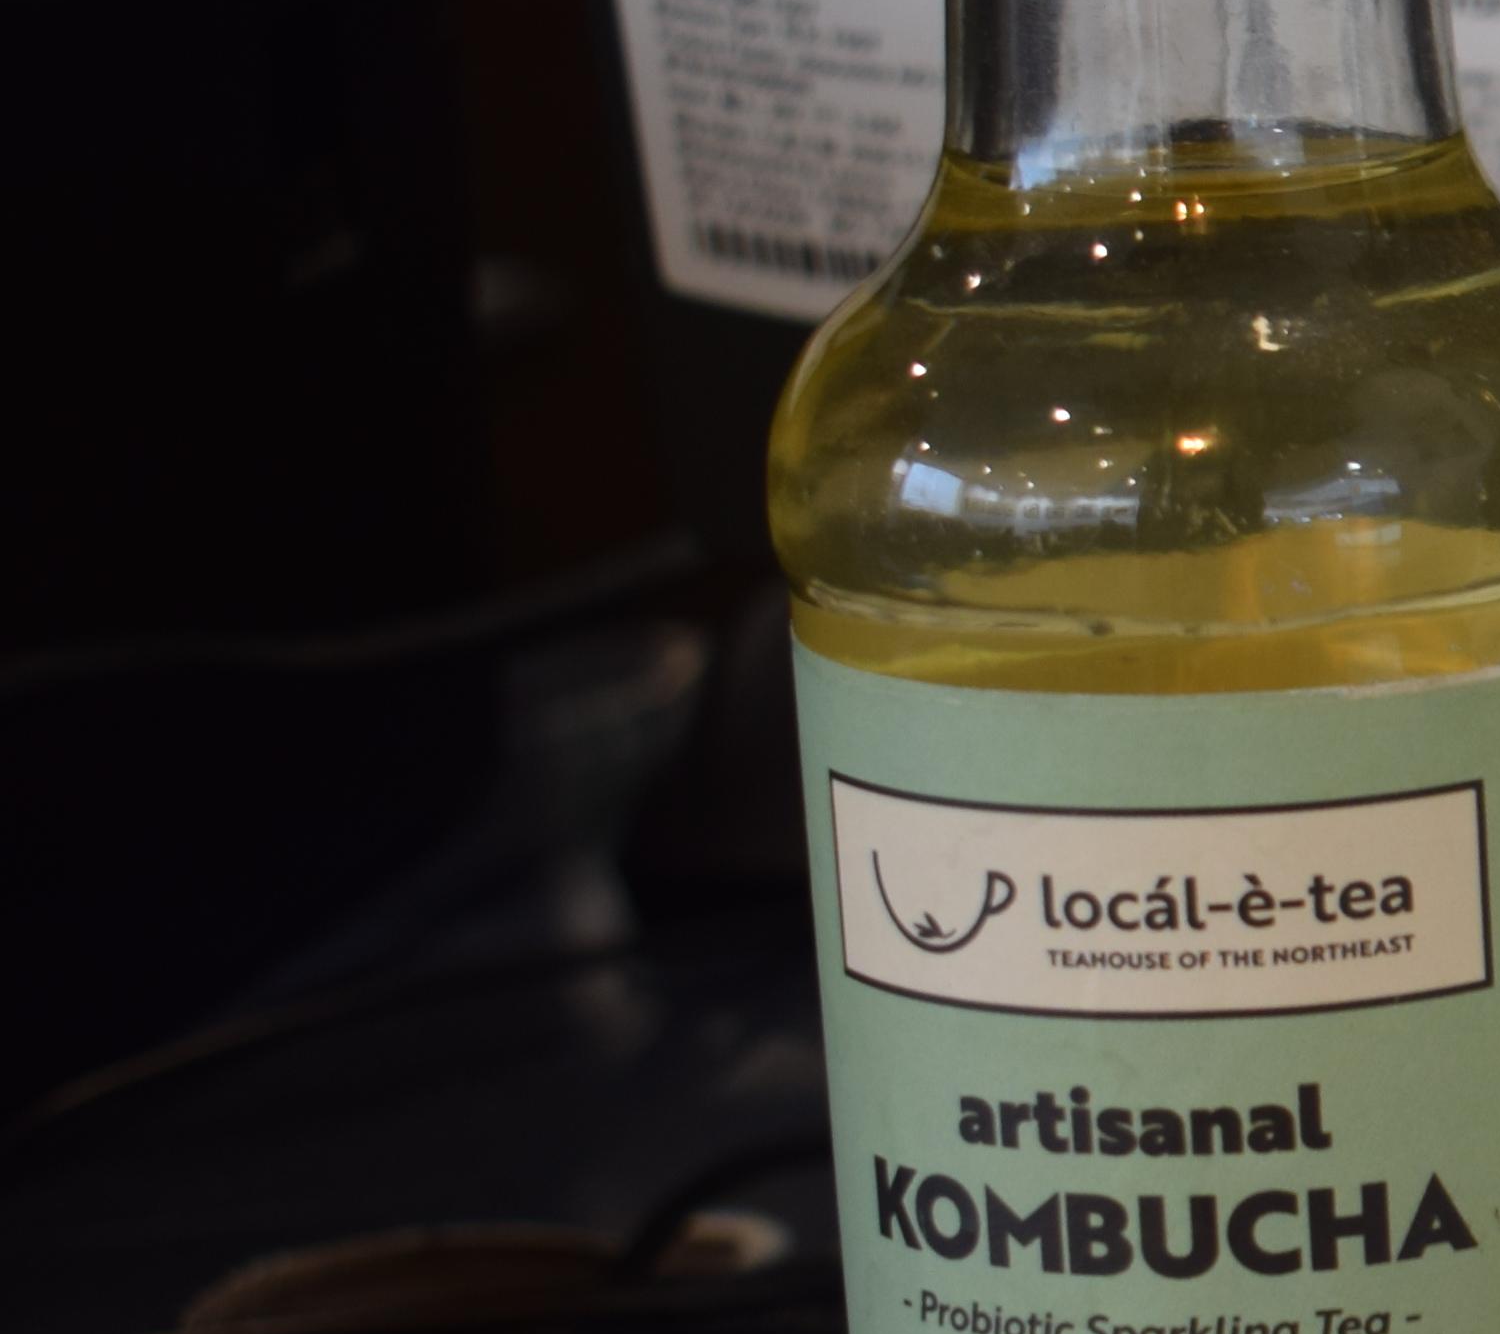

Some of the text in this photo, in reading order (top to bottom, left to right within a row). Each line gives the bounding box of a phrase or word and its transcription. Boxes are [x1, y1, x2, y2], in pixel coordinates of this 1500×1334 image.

[1041, 873, 1413, 932] locál-è-tea
[1048, 934, 1414, 970] TEAHOUSE OF THE NORTHEAST
[958, 1083, 1331, 1157] artisanal
[873, 1154, 1478, 1278] KOMBUCHA
